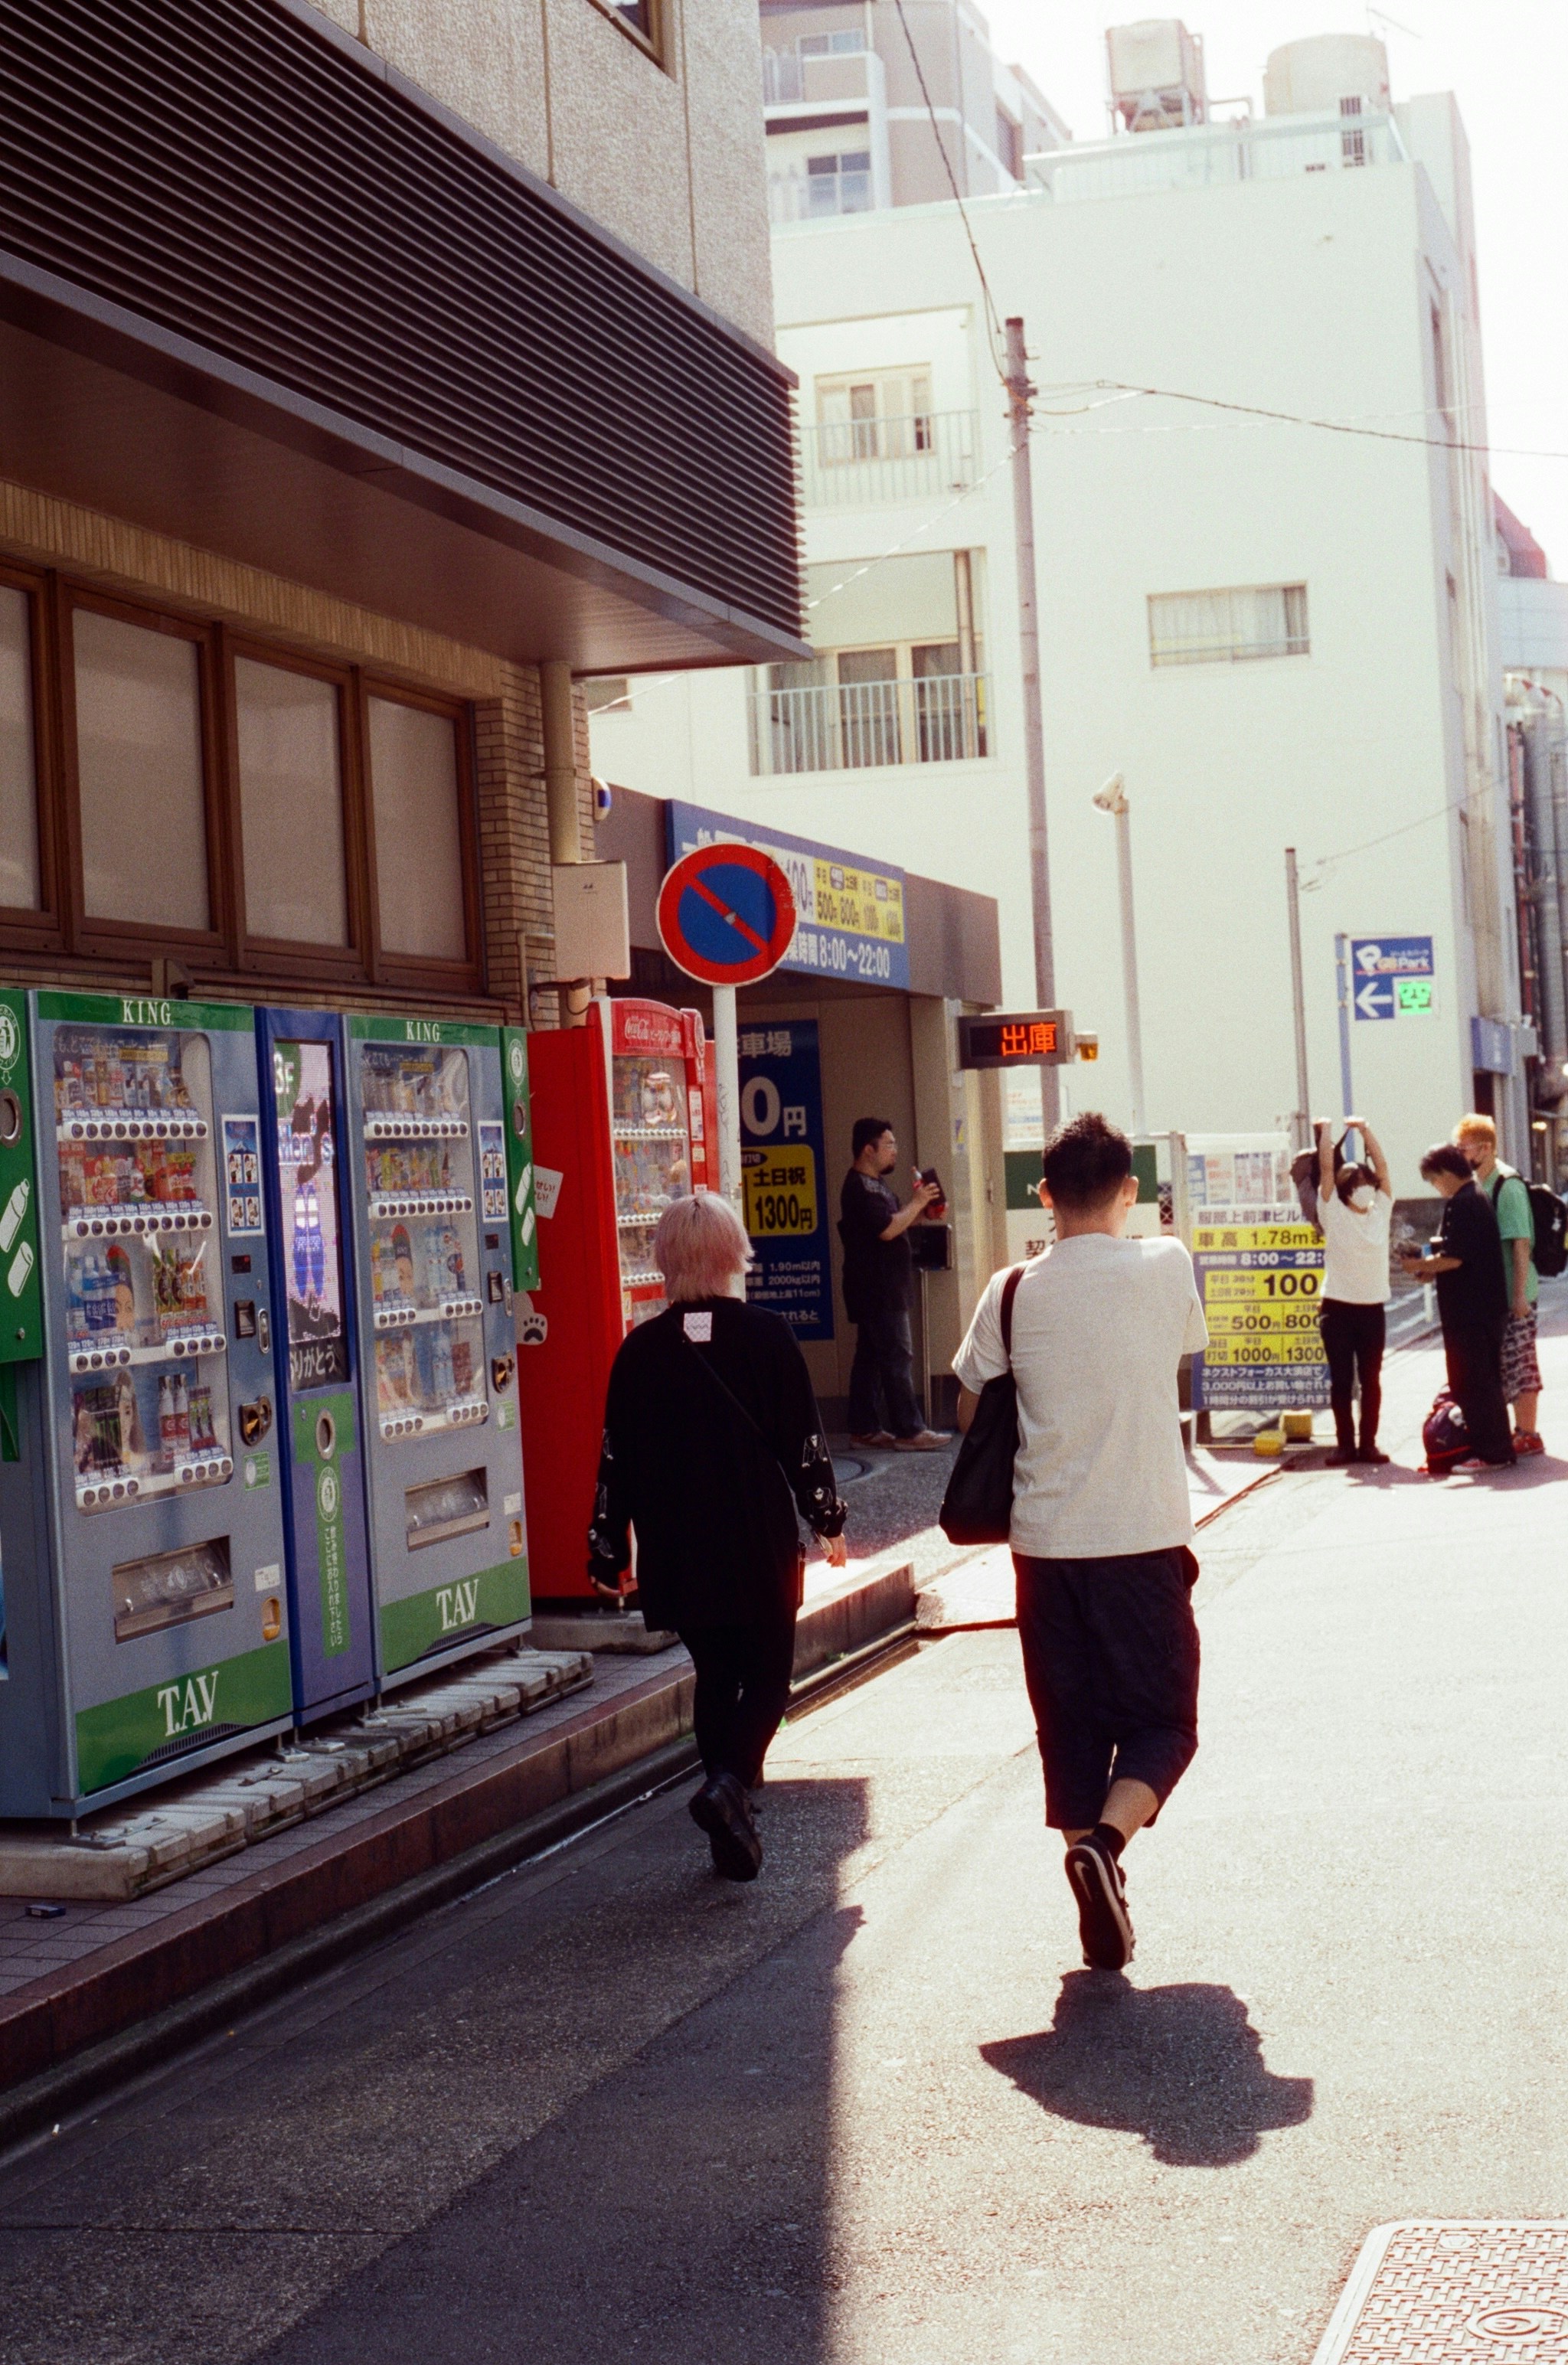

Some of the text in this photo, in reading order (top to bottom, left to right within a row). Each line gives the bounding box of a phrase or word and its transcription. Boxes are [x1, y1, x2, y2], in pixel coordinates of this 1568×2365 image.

[783, 930, 818, 967] 業時間
[122, 999, 172, 1026] KING
[1399, 981, 1432, 1016] 空
[405, 1021, 442, 1043] KING
[1001, 1022, 1057, 1057] 出庫
[753, 1167, 806, 1187] 土日祝
[755, 1194, 813, 1231] 1300円
